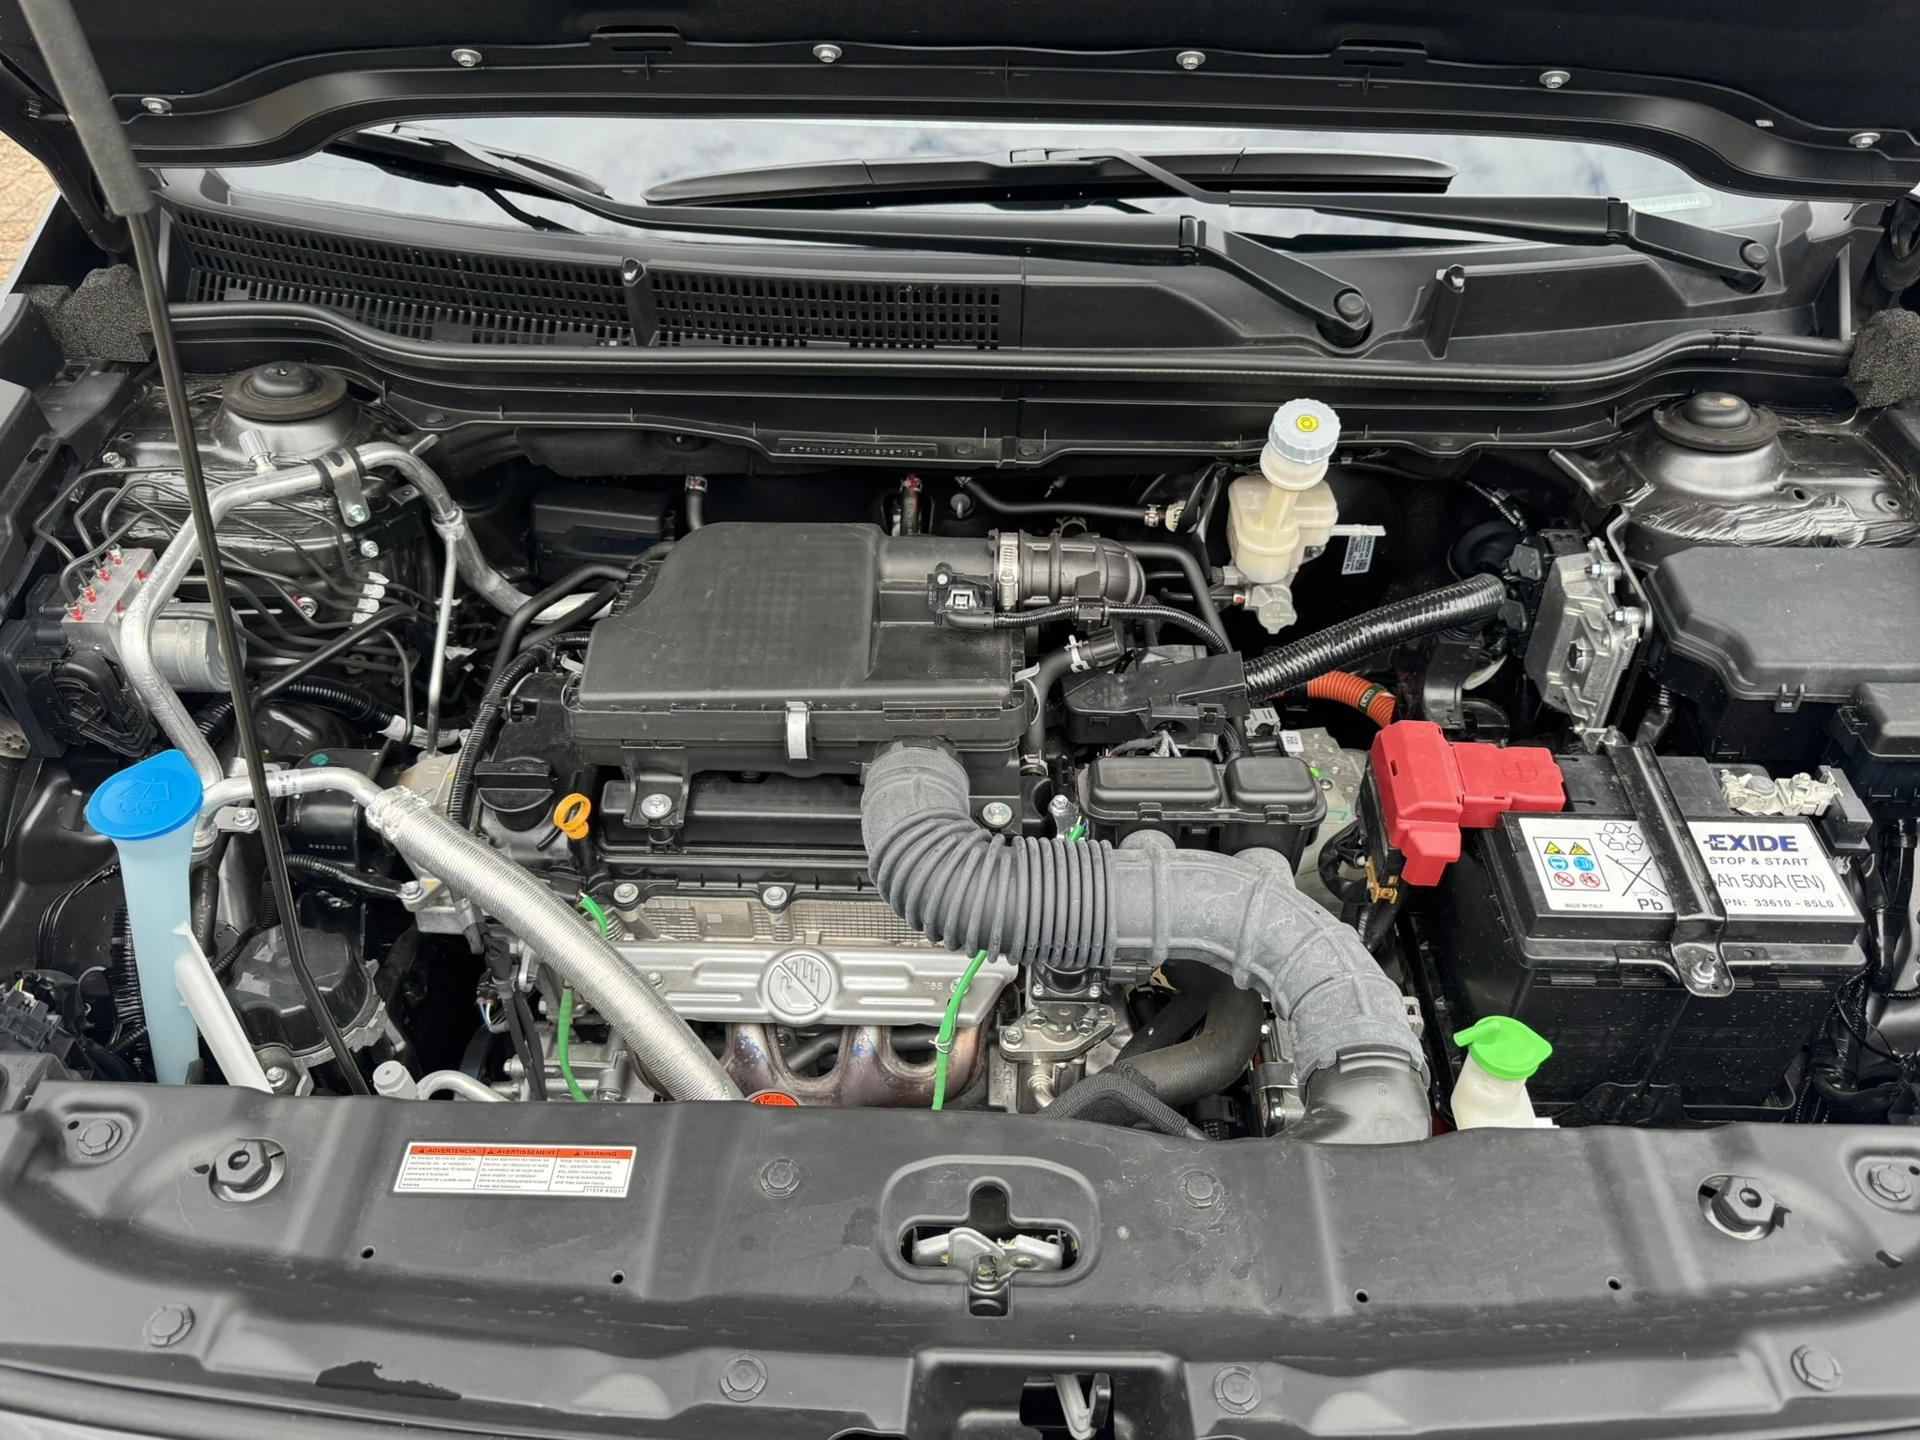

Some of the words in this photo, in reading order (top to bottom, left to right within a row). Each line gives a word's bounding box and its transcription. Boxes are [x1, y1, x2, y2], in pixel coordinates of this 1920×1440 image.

[1703, 834, 1798, 852] EXIDE
[1709, 857, 1746, 865] STOP
[1751, 857, 1760, 865] &
[1764, 857, 1809, 866] START
[1637, 898, 1664, 911] Pb
[1724, 898, 1747, 907] PN:
[1754, 899, 1791, 907] 33610
[1804, 899, 1834, 908] 85L0
